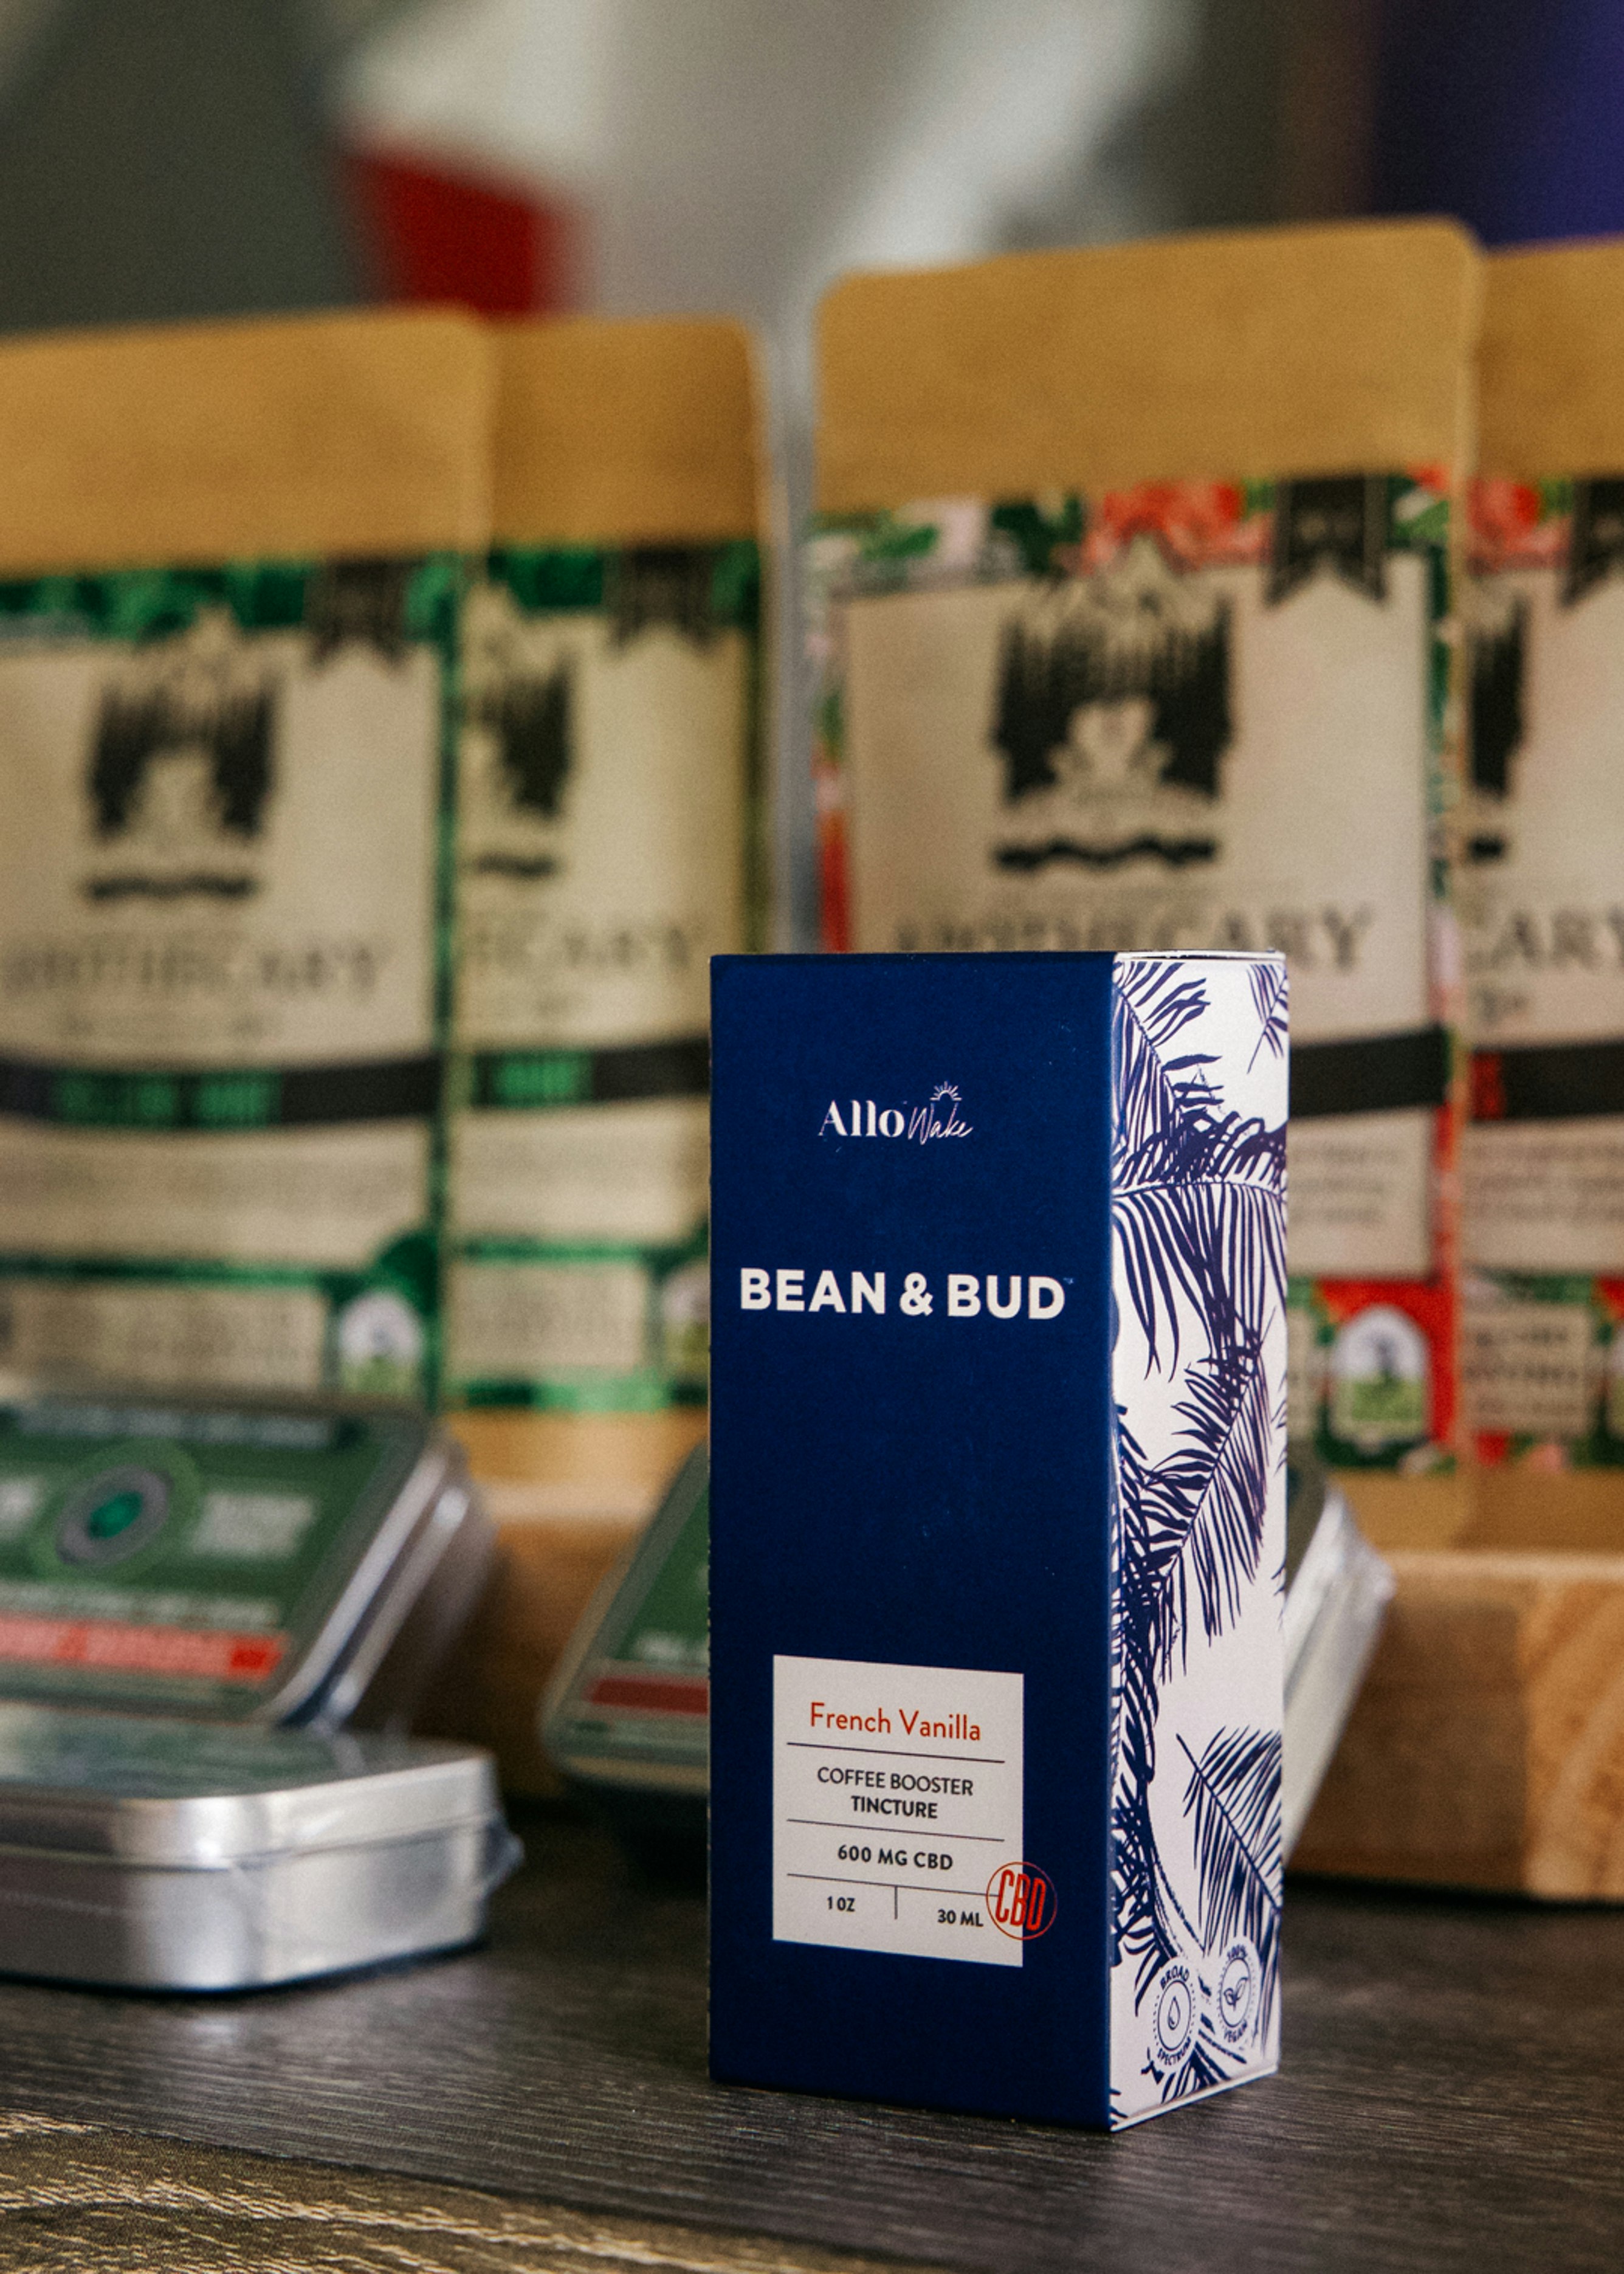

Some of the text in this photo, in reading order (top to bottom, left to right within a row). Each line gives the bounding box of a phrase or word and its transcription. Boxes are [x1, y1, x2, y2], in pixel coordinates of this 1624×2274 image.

[819, 1100, 973, 1145] Allo Wake
[740, 1268, 1065, 1319] BEAN & BUD
[810, 1701, 981, 1741] French Vanilla
[817, 1766, 974, 1796] COFFEE BOOSTER
[851, 1796, 938, 1819] TINCTURE
[838, 1845, 953, 1870] 600 MG CBD
[996, 1869, 1047, 1931] CBD
[937, 1909, 984, 1928] 30 ML
[1160, 1965, 1189, 1990] BROAD
[1157, 2036, 1191, 2066] SPECTRUM
